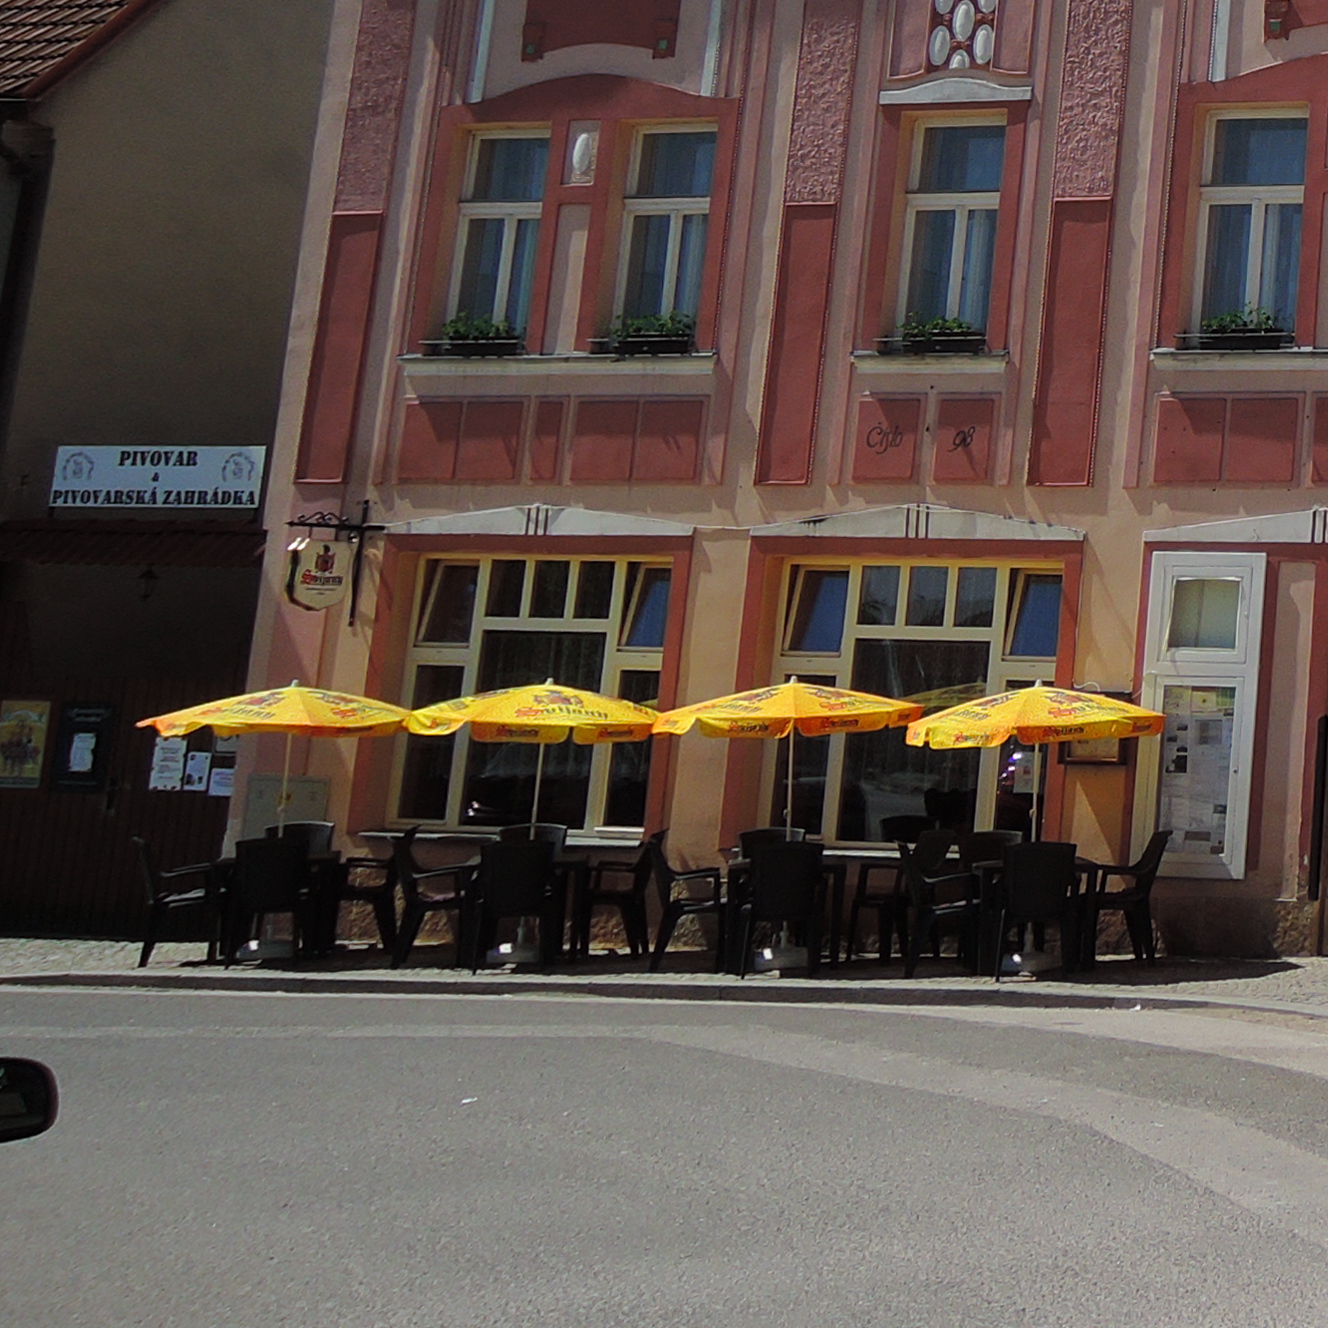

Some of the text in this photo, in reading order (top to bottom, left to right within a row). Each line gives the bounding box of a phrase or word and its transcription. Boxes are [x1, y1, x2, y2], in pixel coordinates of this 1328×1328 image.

[947, 425, 976, 452] 98
[118, 450, 199, 467] PIVOVAR
[152, 472, 160, 482] &
[51, 486, 256, 506] PIVOVARSKÁ ZAHRÁDKA
